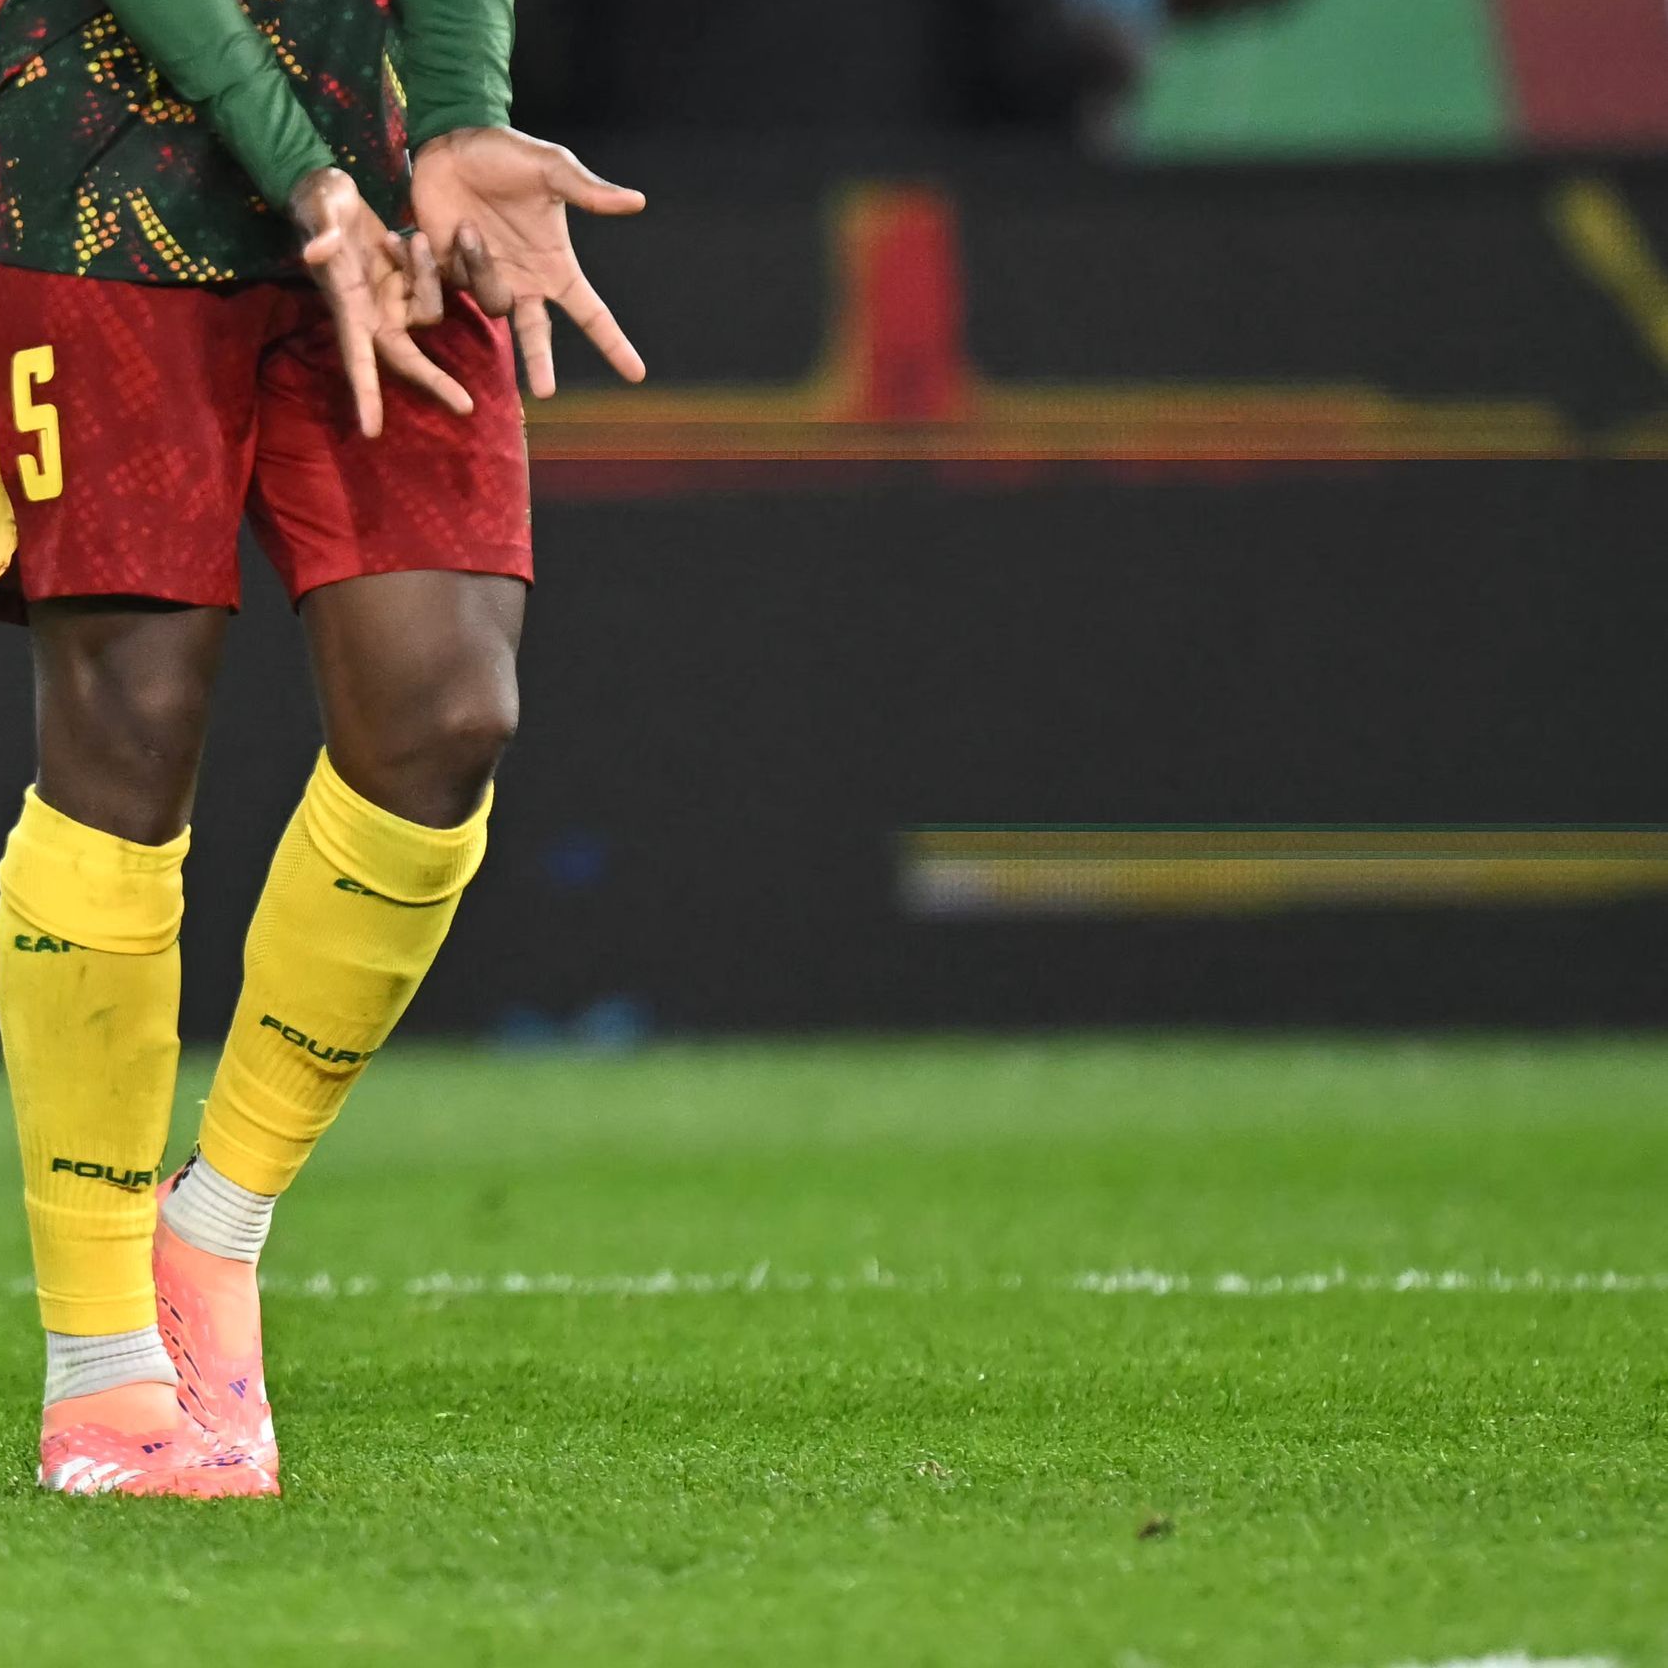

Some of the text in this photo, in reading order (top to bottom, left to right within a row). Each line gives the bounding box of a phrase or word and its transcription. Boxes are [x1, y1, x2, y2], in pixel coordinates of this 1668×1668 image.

[11, 344, 63, 502] 5
[260, 1014, 375, 1064] FOUR
[52, 1158, 160, 1187] FOUR
